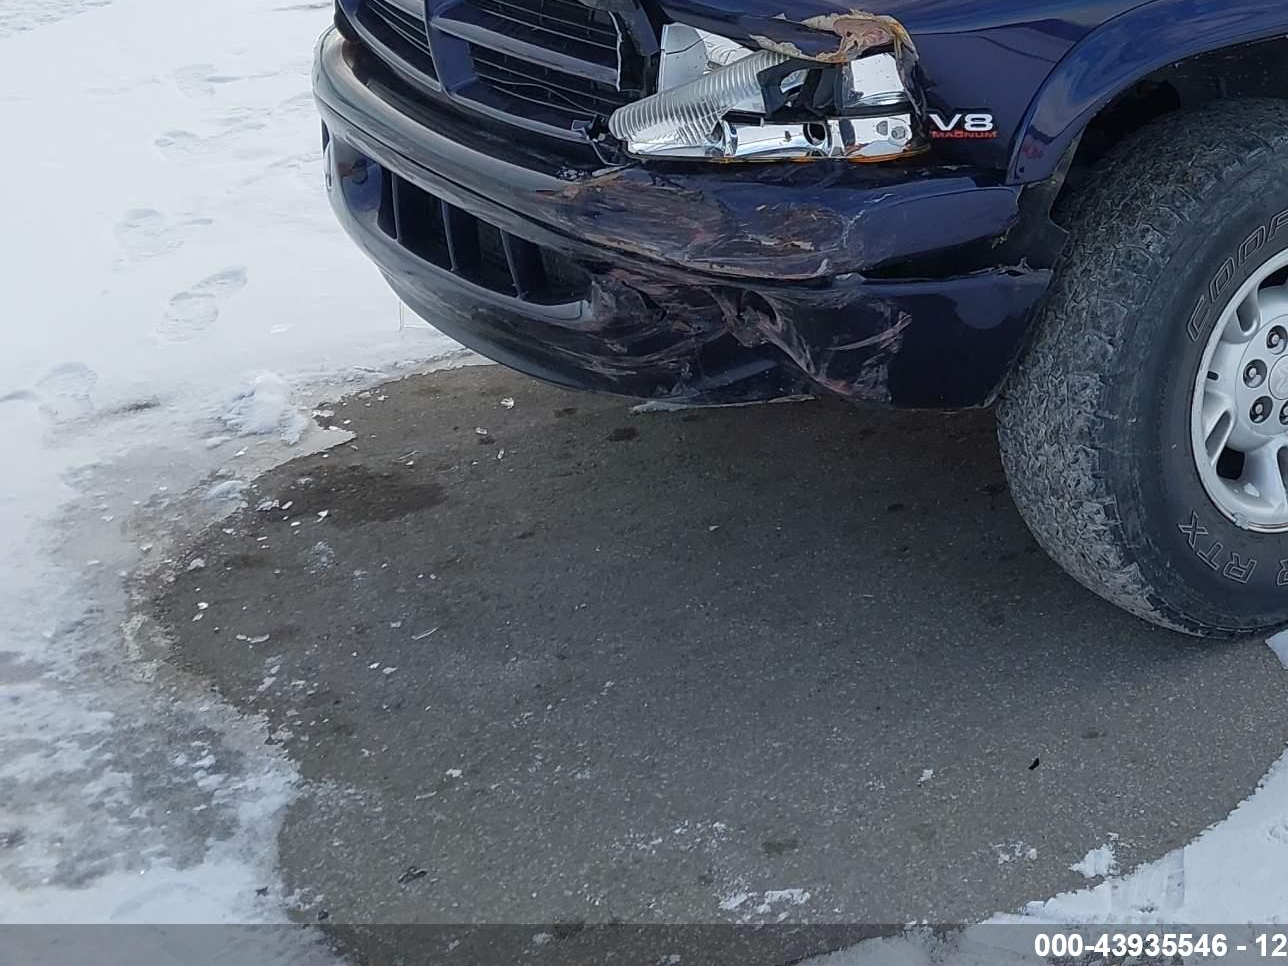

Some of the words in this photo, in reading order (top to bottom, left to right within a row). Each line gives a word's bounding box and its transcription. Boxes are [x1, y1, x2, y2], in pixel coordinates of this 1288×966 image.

[929, 113, 994, 132] V8
[930, 130, 998, 139] MAGNUM
[1177, 510, 1257, 584] RTX
